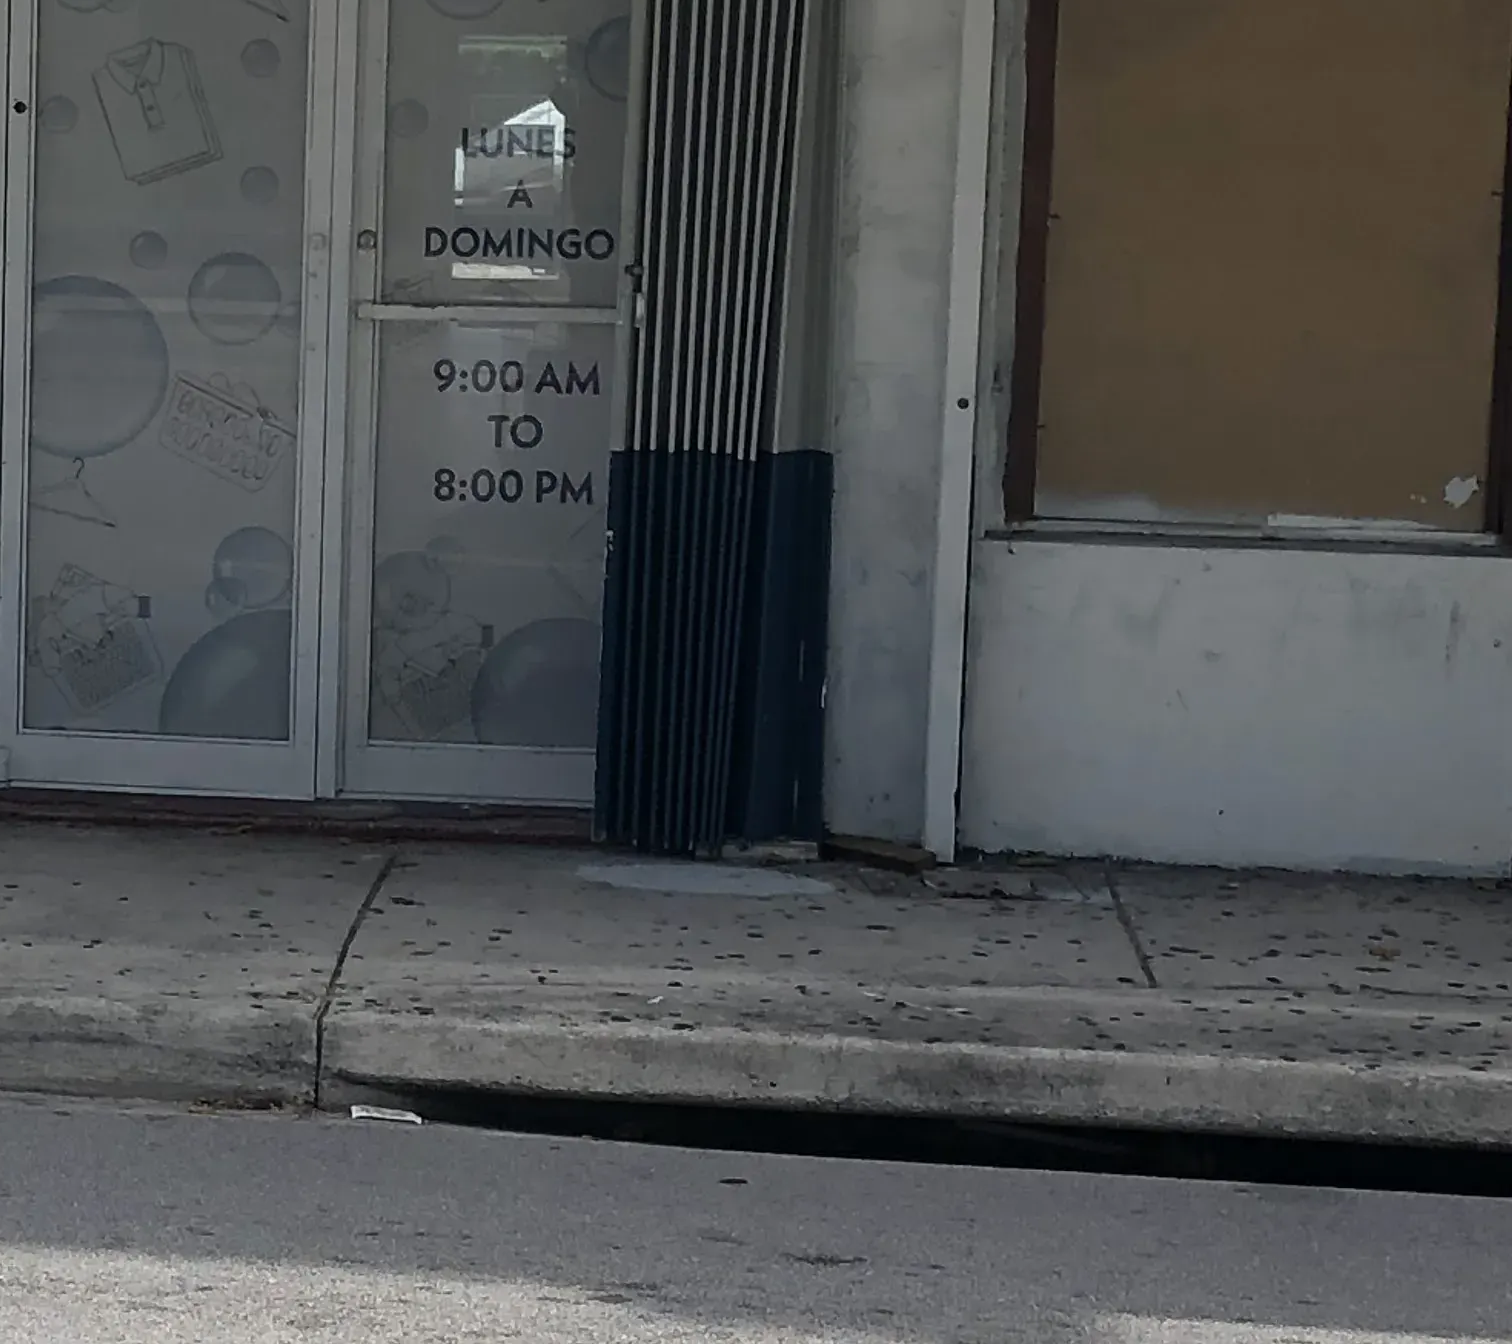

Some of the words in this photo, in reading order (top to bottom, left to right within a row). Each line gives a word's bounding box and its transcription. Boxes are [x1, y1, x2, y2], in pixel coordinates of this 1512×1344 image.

[461, 126, 577, 161] LUNES
[506, 179, 533, 209] A
[423, 226, 615, 261] DOMINGO
[432, 358, 524, 394] 9:00
[534, 361, 601, 397] AM
[487, 414, 544, 449] TO
[433, 467, 524, 504] 8:00
[535, 470, 594, 506] PM
